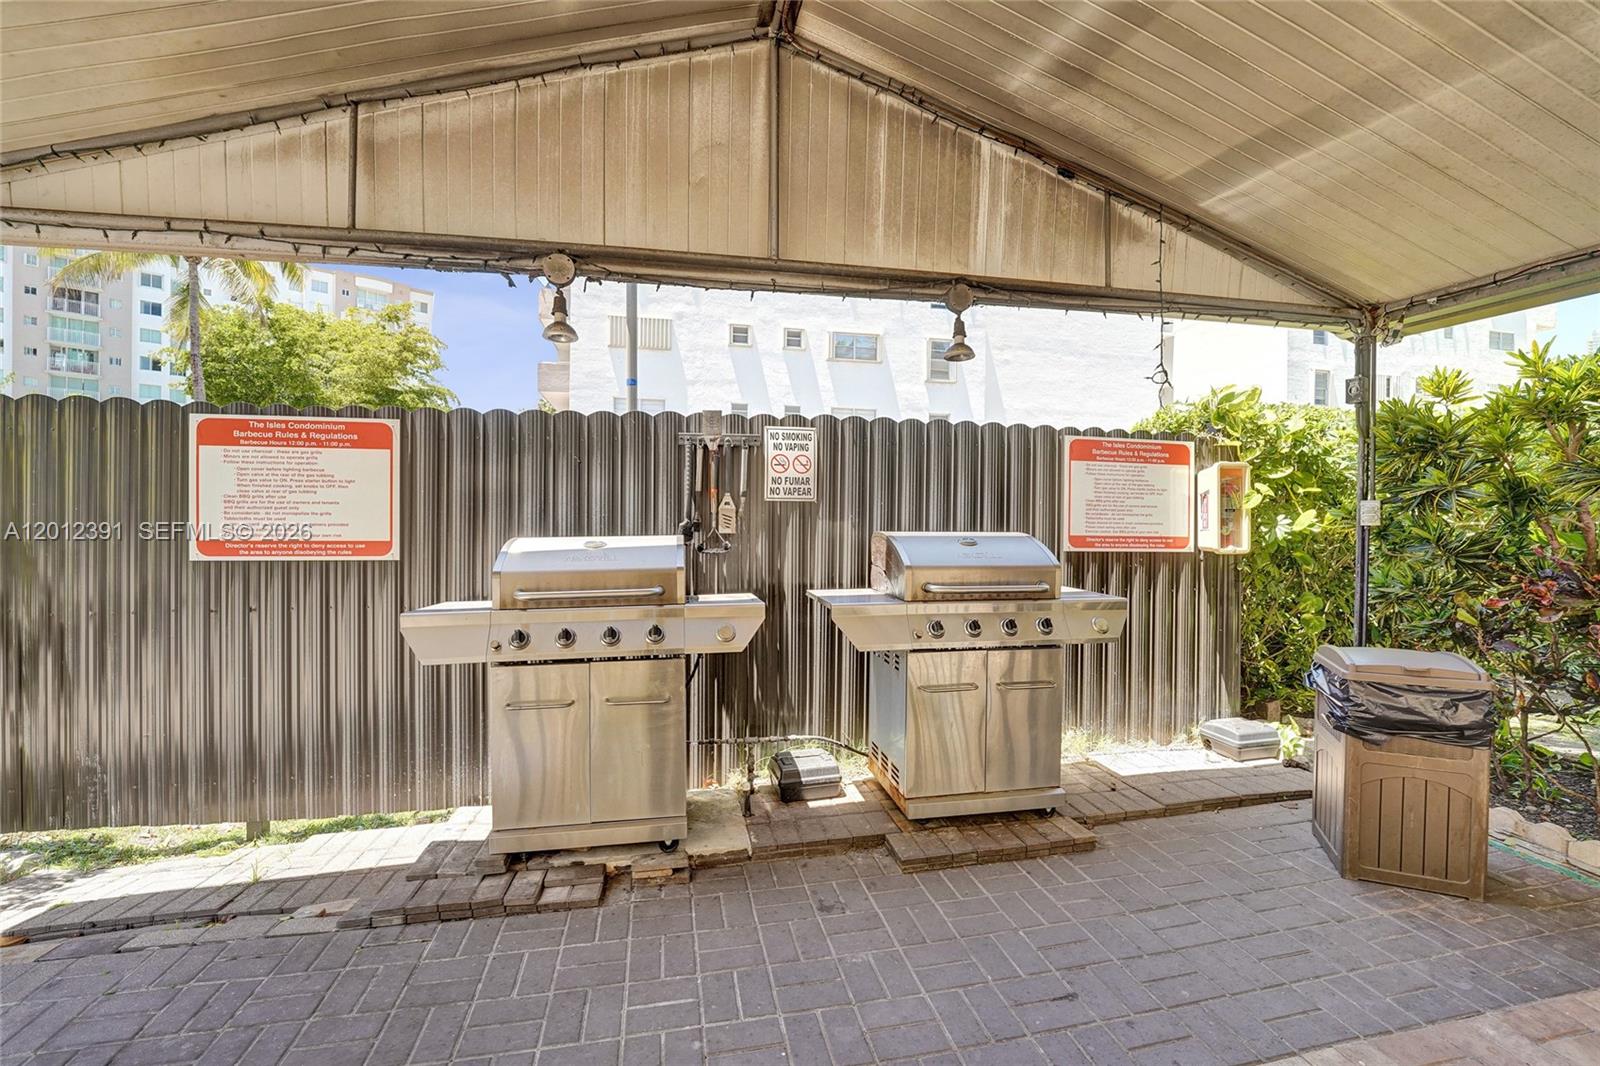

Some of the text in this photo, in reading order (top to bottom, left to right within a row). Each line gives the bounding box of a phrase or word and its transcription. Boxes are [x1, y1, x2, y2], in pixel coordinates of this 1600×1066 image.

[288, 422, 345, 430] Condominium
[234, 430, 272, 438] Barbecue
[310, 432, 358, 440] Regulations
[770, 432, 812, 442] NO SMOKING
[773, 442, 809, 452] NO VAPING
[772, 476, 810, 486] NO FUMAR
[769, 487, 812, 496] NO VAPEAR
